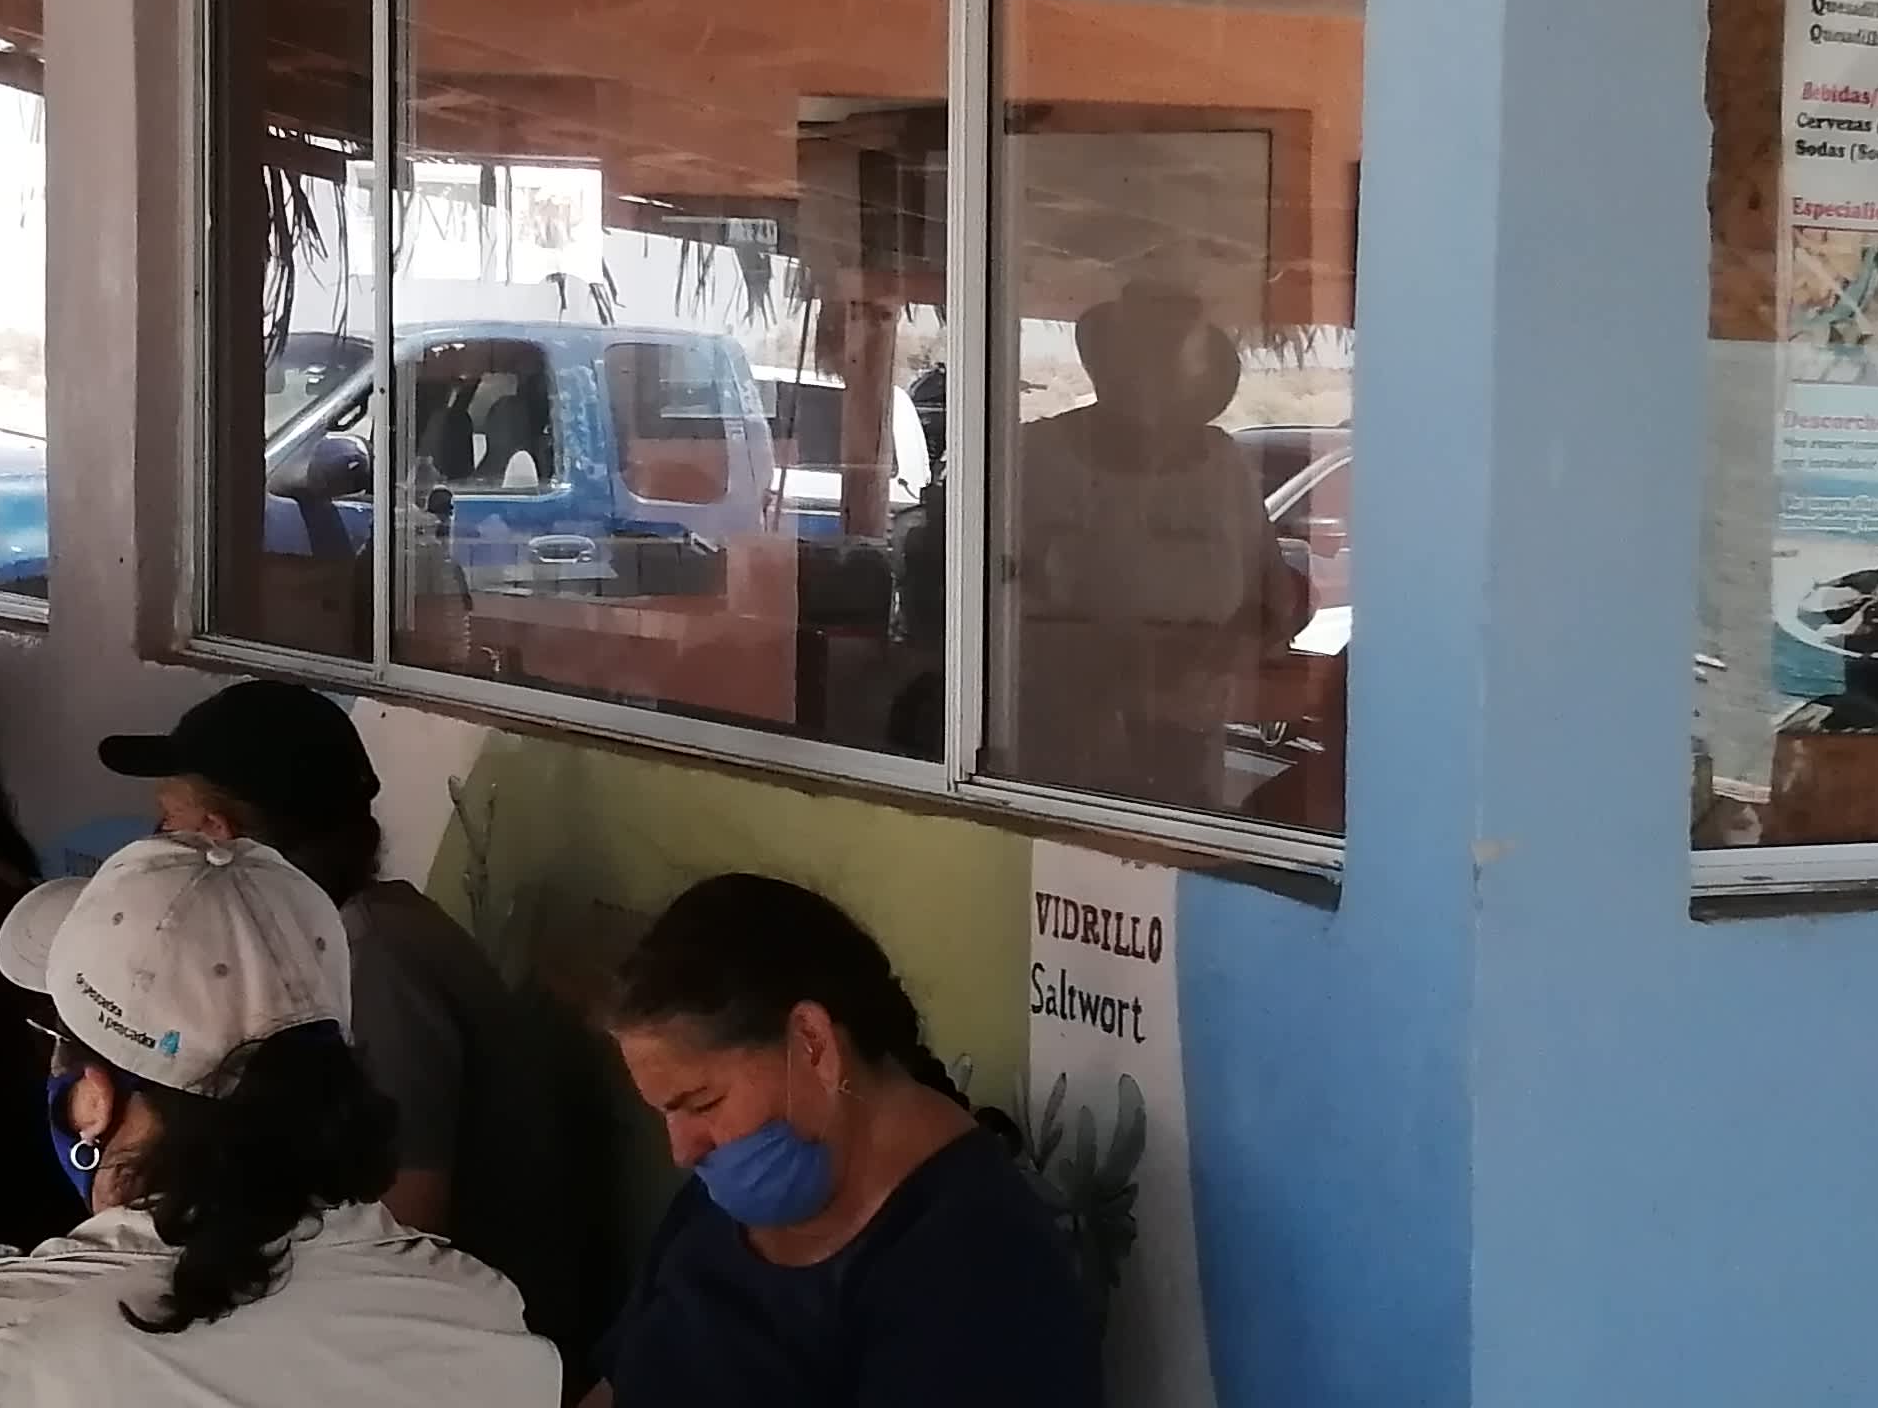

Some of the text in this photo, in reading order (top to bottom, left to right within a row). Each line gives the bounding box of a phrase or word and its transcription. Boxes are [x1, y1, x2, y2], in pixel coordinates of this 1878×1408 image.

[1795, 140, 1845, 159] Sodas
[1035, 892, 1163, 964] VIDRILLO
[1031, 963, 1147, 1043] Saltwort
